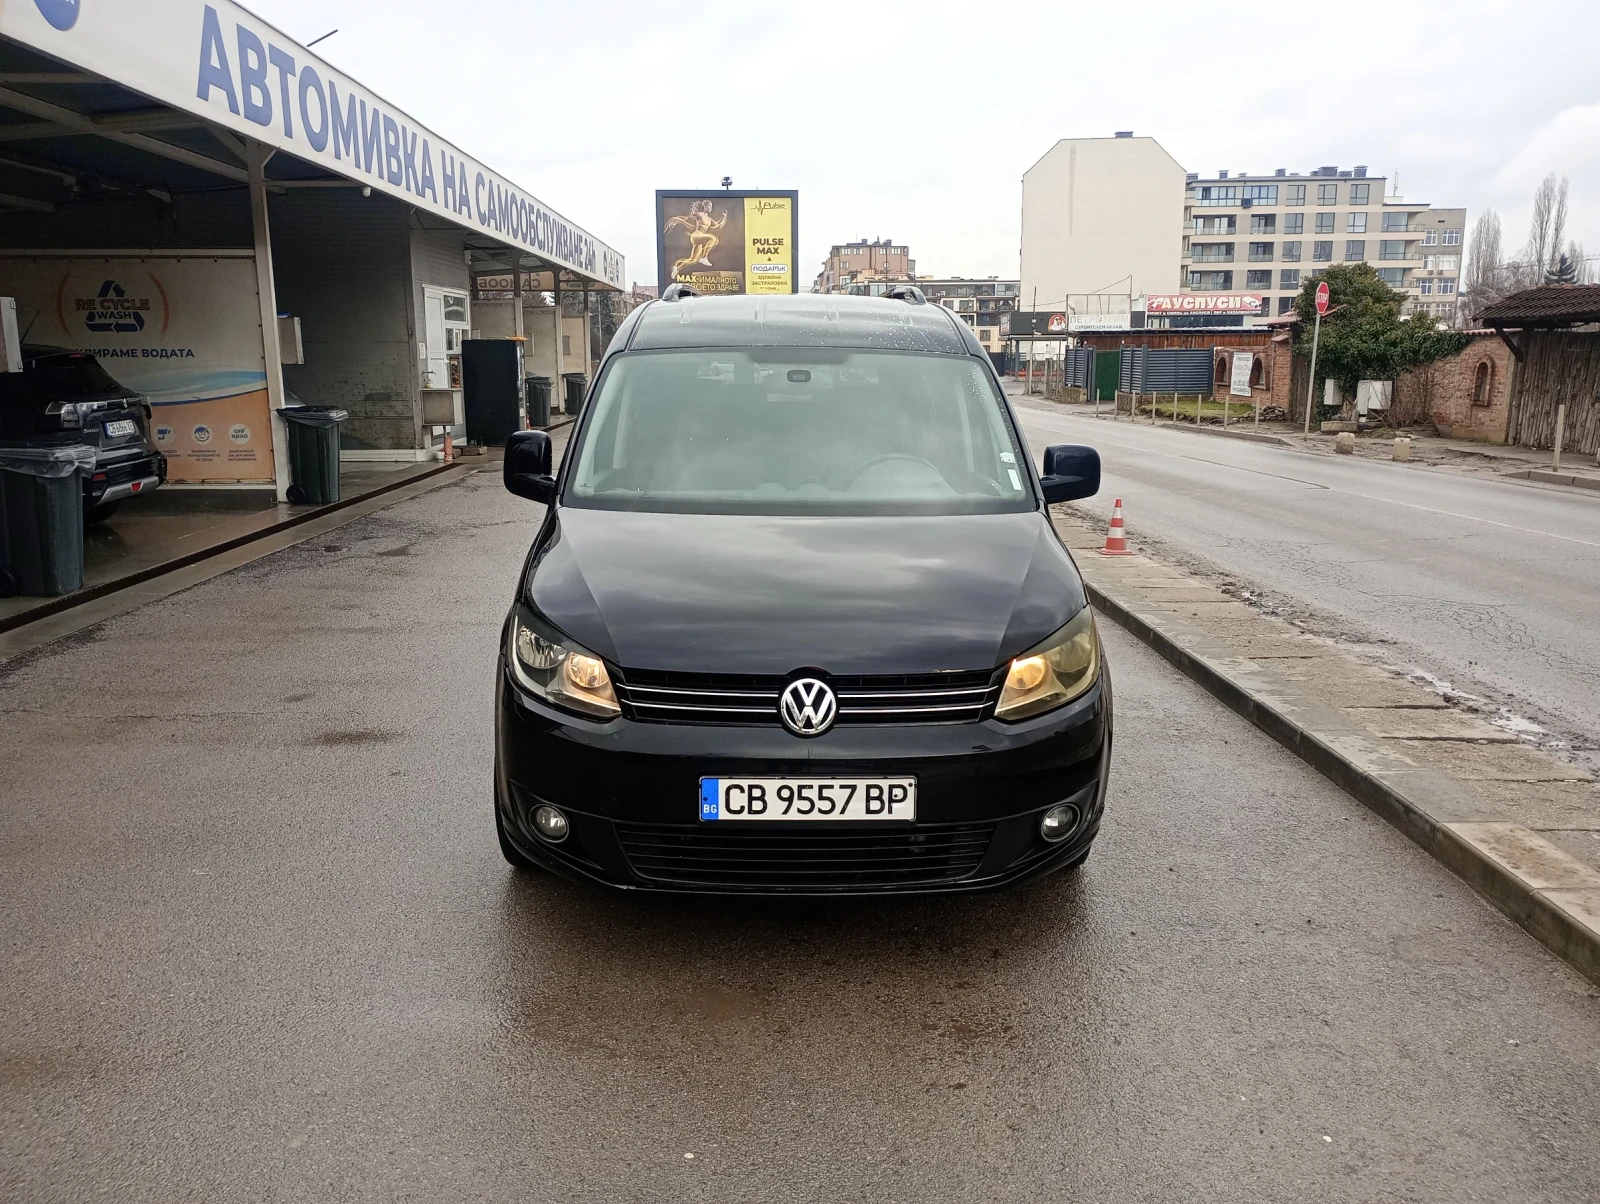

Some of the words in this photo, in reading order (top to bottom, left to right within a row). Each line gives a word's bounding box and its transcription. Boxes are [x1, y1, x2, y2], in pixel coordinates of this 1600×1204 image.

[197, 4, 437, 205] АВТОМИВКА
[440, 149, 472, 219] НА
[476, 171, 583, 269] САМООБСЛУЖВАНЕ
[763, 201, 786, 209] Pulse
[752, 238, 784, 246] PULSE
[757, 247, 779, 255] MAX
[753, 265, 787, 273] ПОДАРЪК
[717, 284, 740, 292] ЗДРАВЕ
[1318, 292, 1328, 303] STOP
[76, 299, 96, 310] RE
[100, 299, 150, 310] CYCLE
[1161, 296, 1242, 310] АУСПУСИ
[96, 311, 132, 319] WASH
[142, 348, 195, 359] ВОДАТА
[776, 783, 858, 815] 9557
[703, 804, 717, 814] BG
